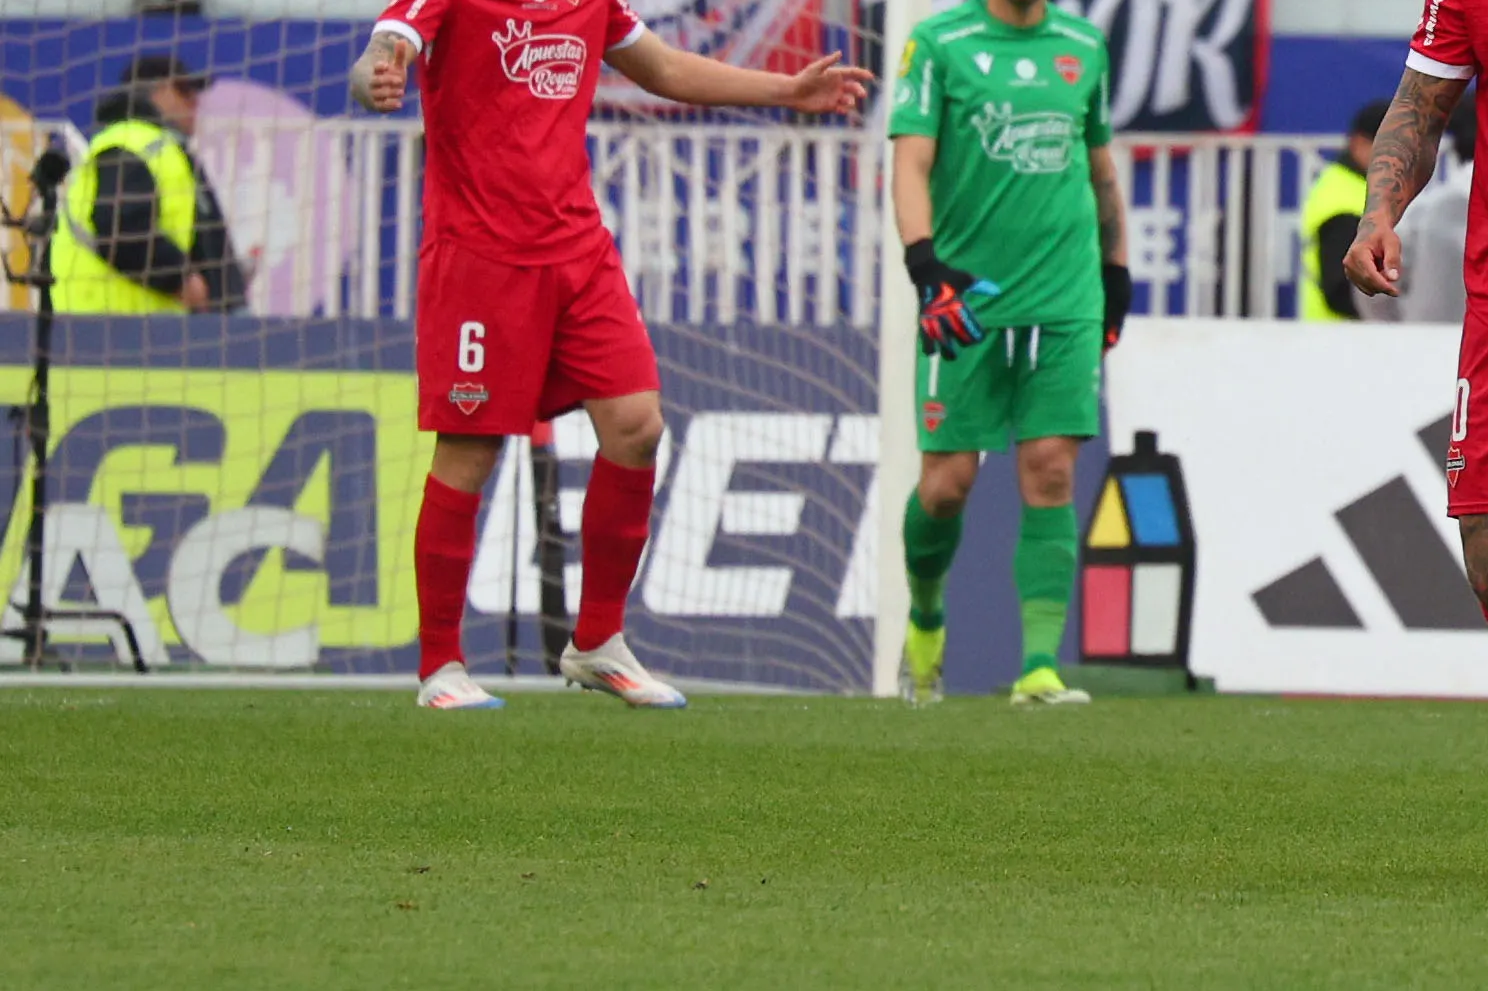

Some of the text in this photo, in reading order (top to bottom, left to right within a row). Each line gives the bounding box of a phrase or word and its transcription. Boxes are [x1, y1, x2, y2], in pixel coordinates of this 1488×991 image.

[511, 40, 581, 74] Apuestas
[535, 68, 579, 95] Royal
[458, 321, 485, 372] 6
